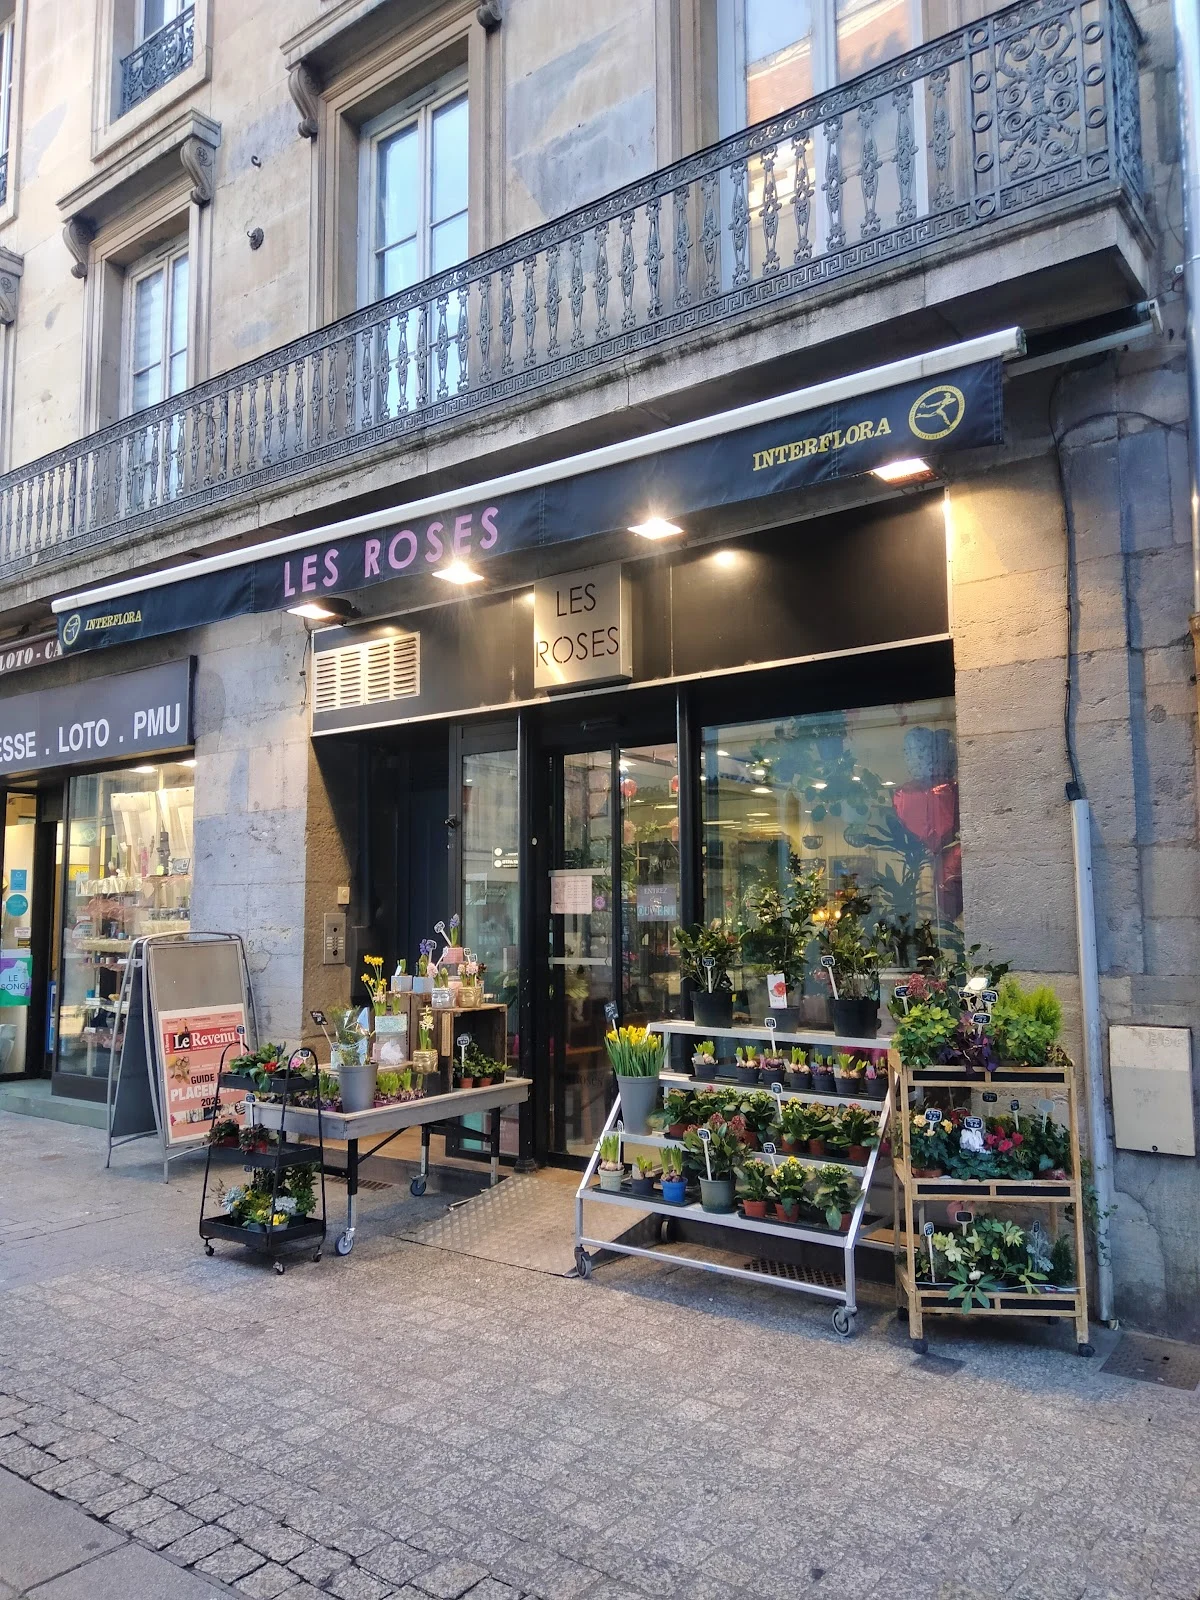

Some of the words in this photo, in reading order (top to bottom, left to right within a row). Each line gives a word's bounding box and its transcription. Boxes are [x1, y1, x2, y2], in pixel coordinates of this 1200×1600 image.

[753, 417, 892, 471] INTERFLORA
[283, 549, 340, 598] LES
[364, 506, 500, 578] ROSES
[556, 583, 597, 617] LES
[84, 610, 142, 631] INTERFLORA
[535, 626, 620, 668] ROSES
[0, 731, 37, 763] SSE
[58, 719, 110, 753] LOTO
[133, 703, 181, 740] PMU
[637, 904, 676, 917] OUVERT
[0, 982, 29, 991] SONGE
[8, 974, 19, 982] LE
[173, 1034, 190, 1050] Le
[191, 1032, 236, 1046] Revenu
[190, 1073, 215, 1084] GUIDE
